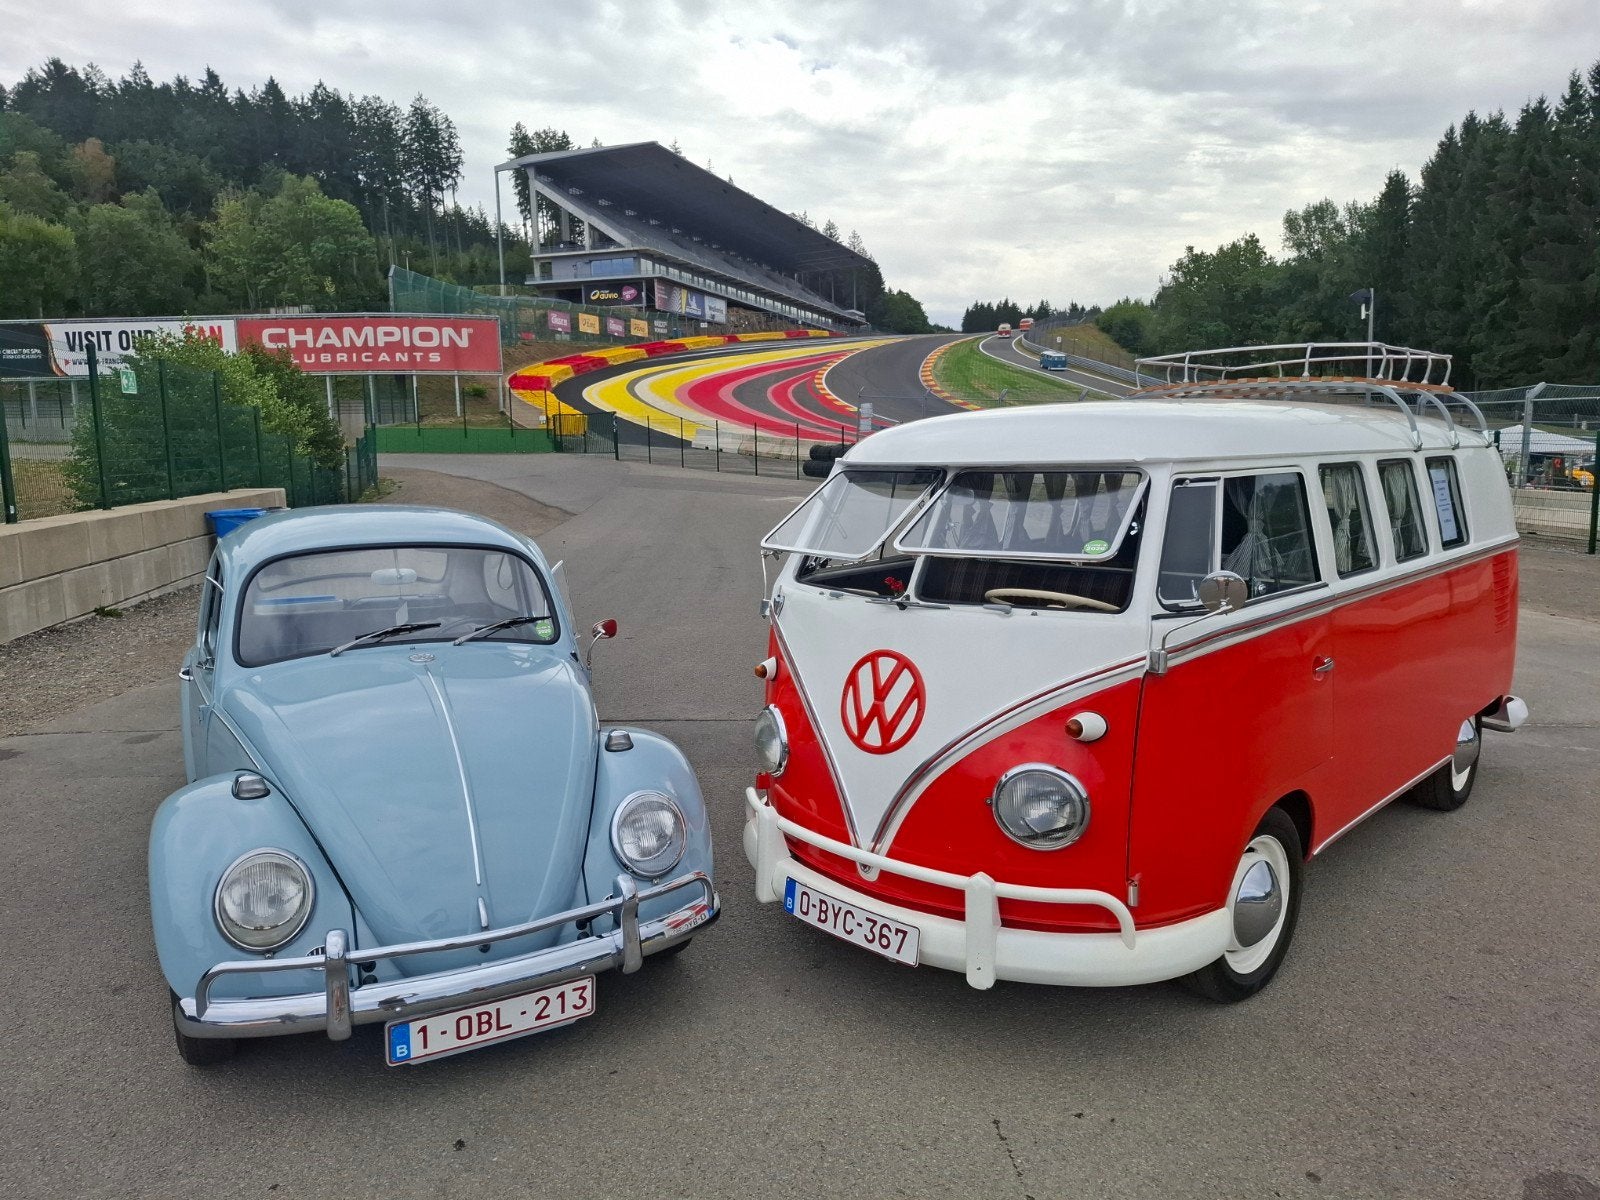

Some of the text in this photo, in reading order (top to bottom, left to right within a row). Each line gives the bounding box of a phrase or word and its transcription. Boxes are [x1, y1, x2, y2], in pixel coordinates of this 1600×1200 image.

[65, 330, 112, 351] VISIT
[262, 327, 469, 348] CHAMPION
[290, 353, 441, 364] LUBRICANTS
[786, 897, 793, 909] B
[396, 1044, 409, 1058] B
